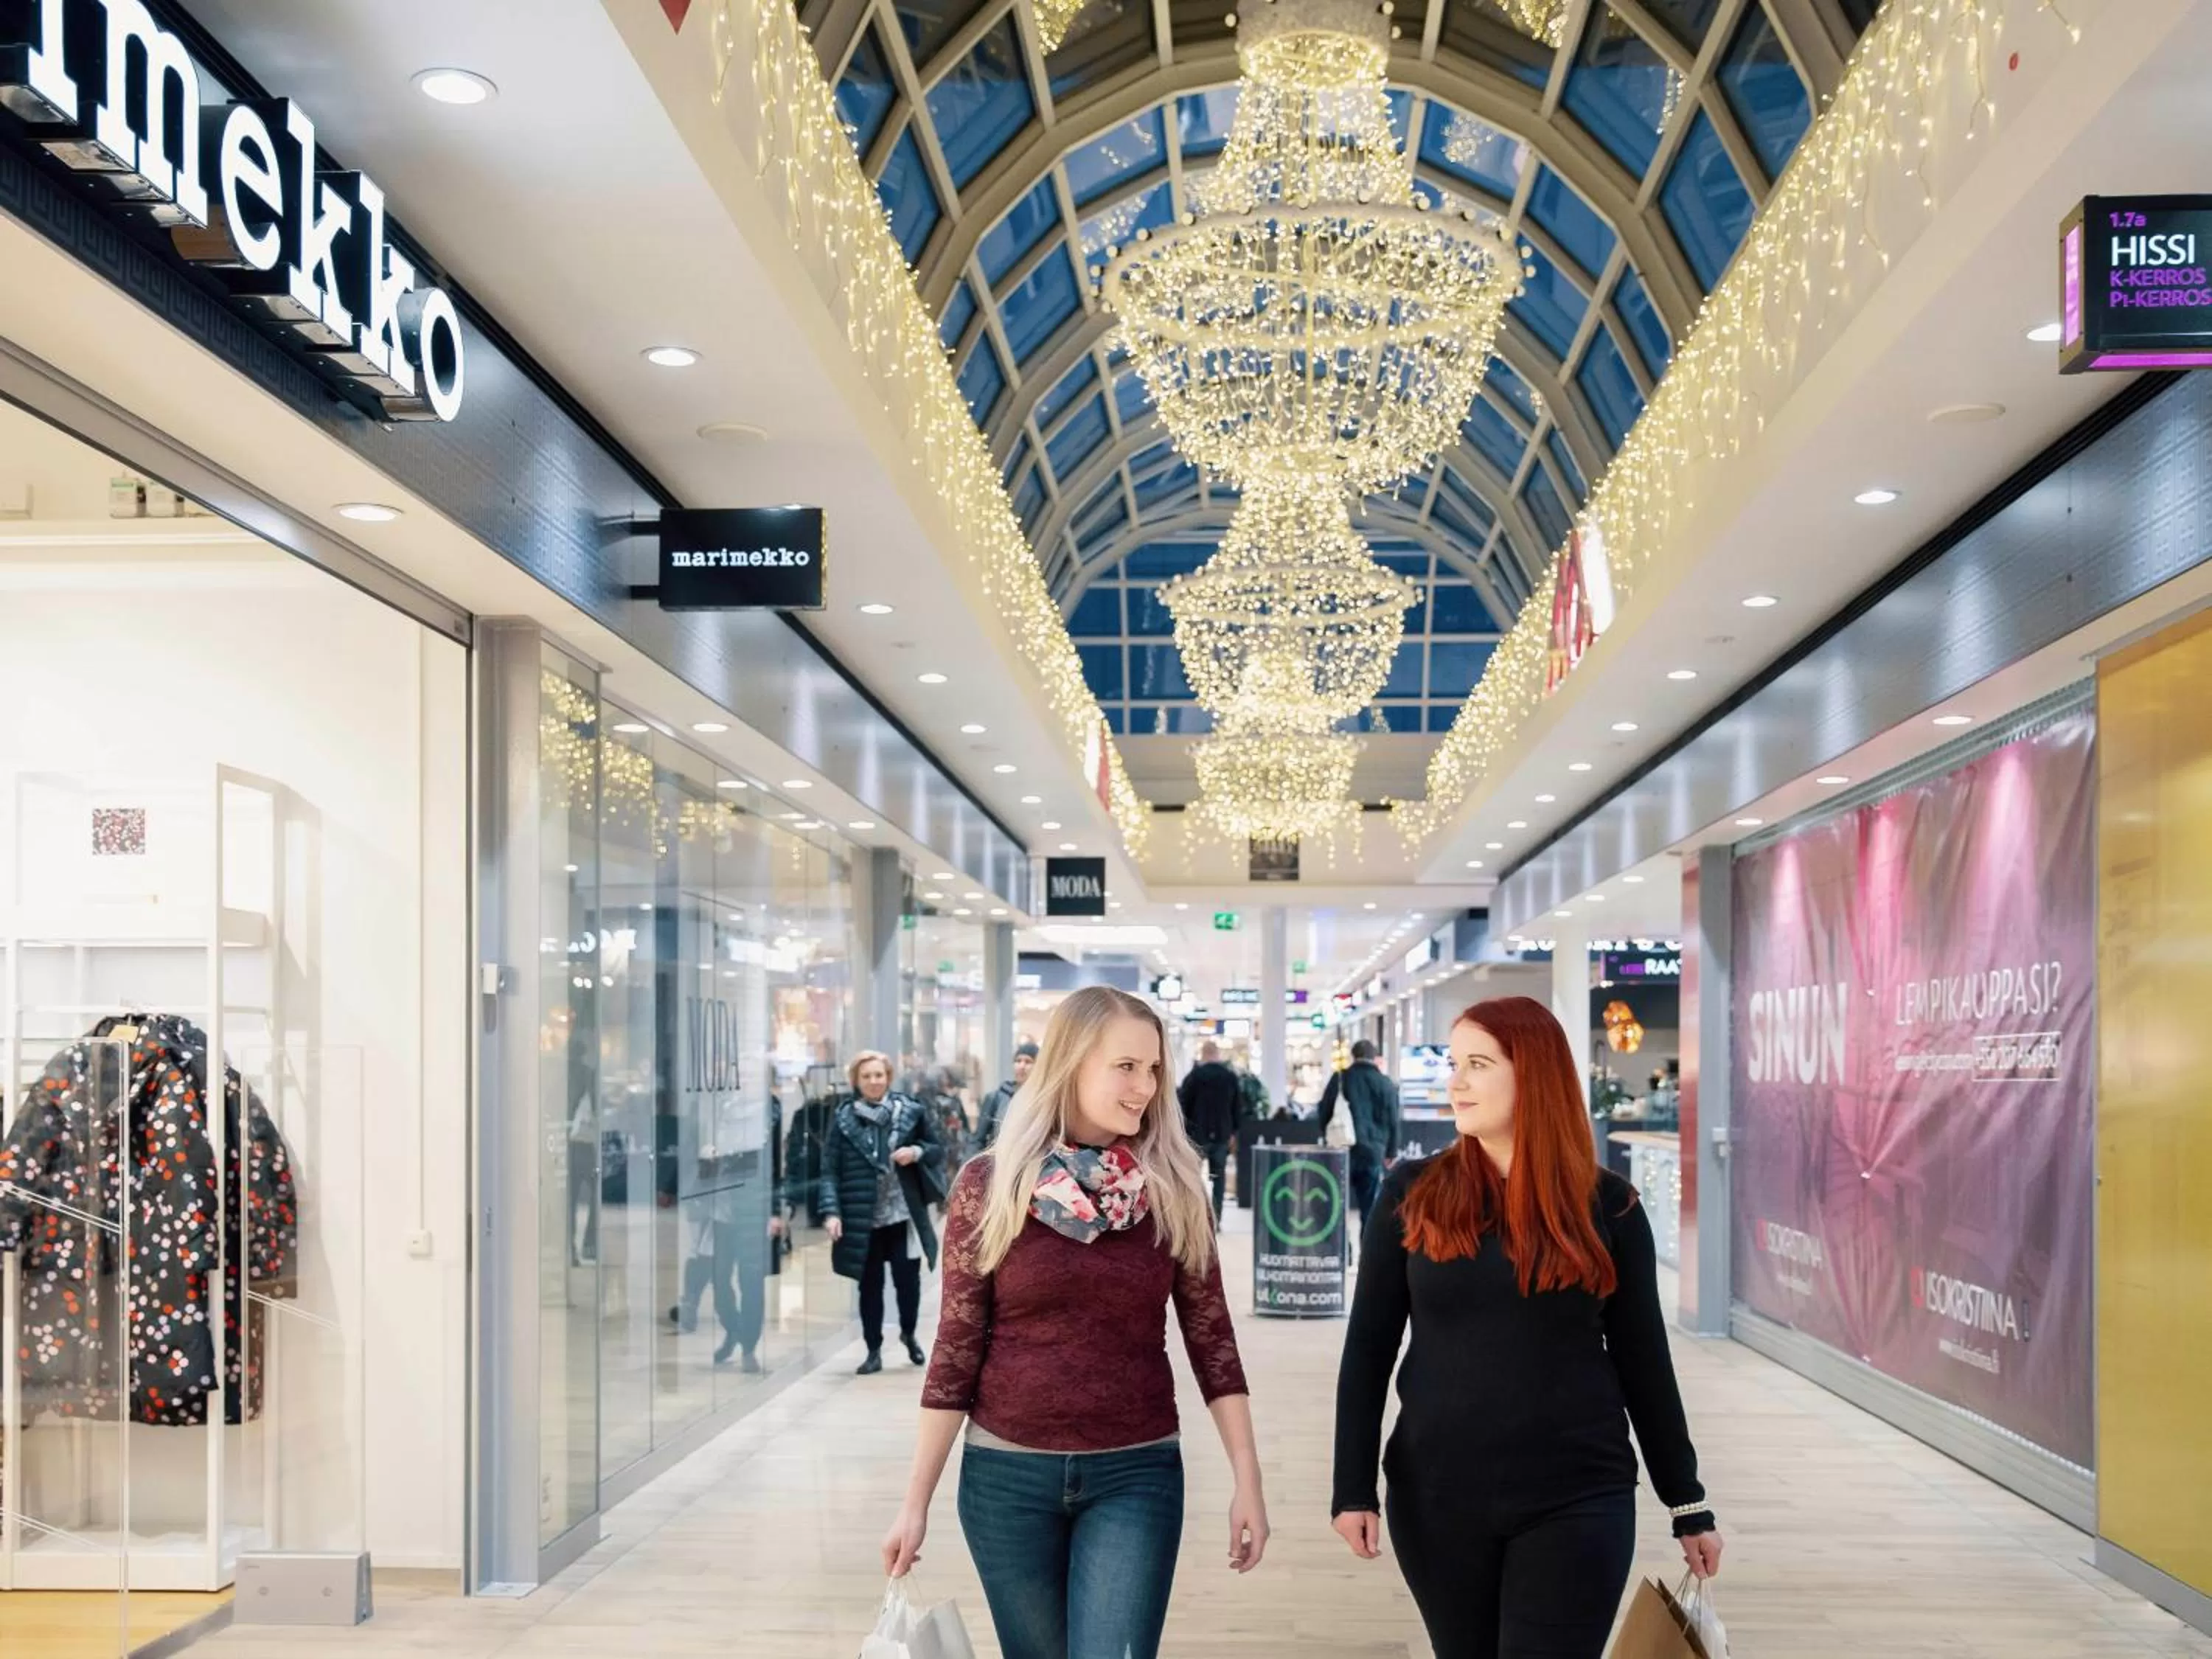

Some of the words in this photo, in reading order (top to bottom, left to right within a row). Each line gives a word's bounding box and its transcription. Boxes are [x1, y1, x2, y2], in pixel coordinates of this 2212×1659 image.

[2111, 234, 2195, 266] HISSI
[2110, 267, 2207, 288] K-KERROS
[672, 548, 810, 567] marimekko
[1050, 874, 1101, 898] MODA
[1644, 958, 1683, 975] RAA
[1896, 961, 2062, 1026] LEMPIKAUPPASI?
[1748, 982, 1847, 1085] SINUN
